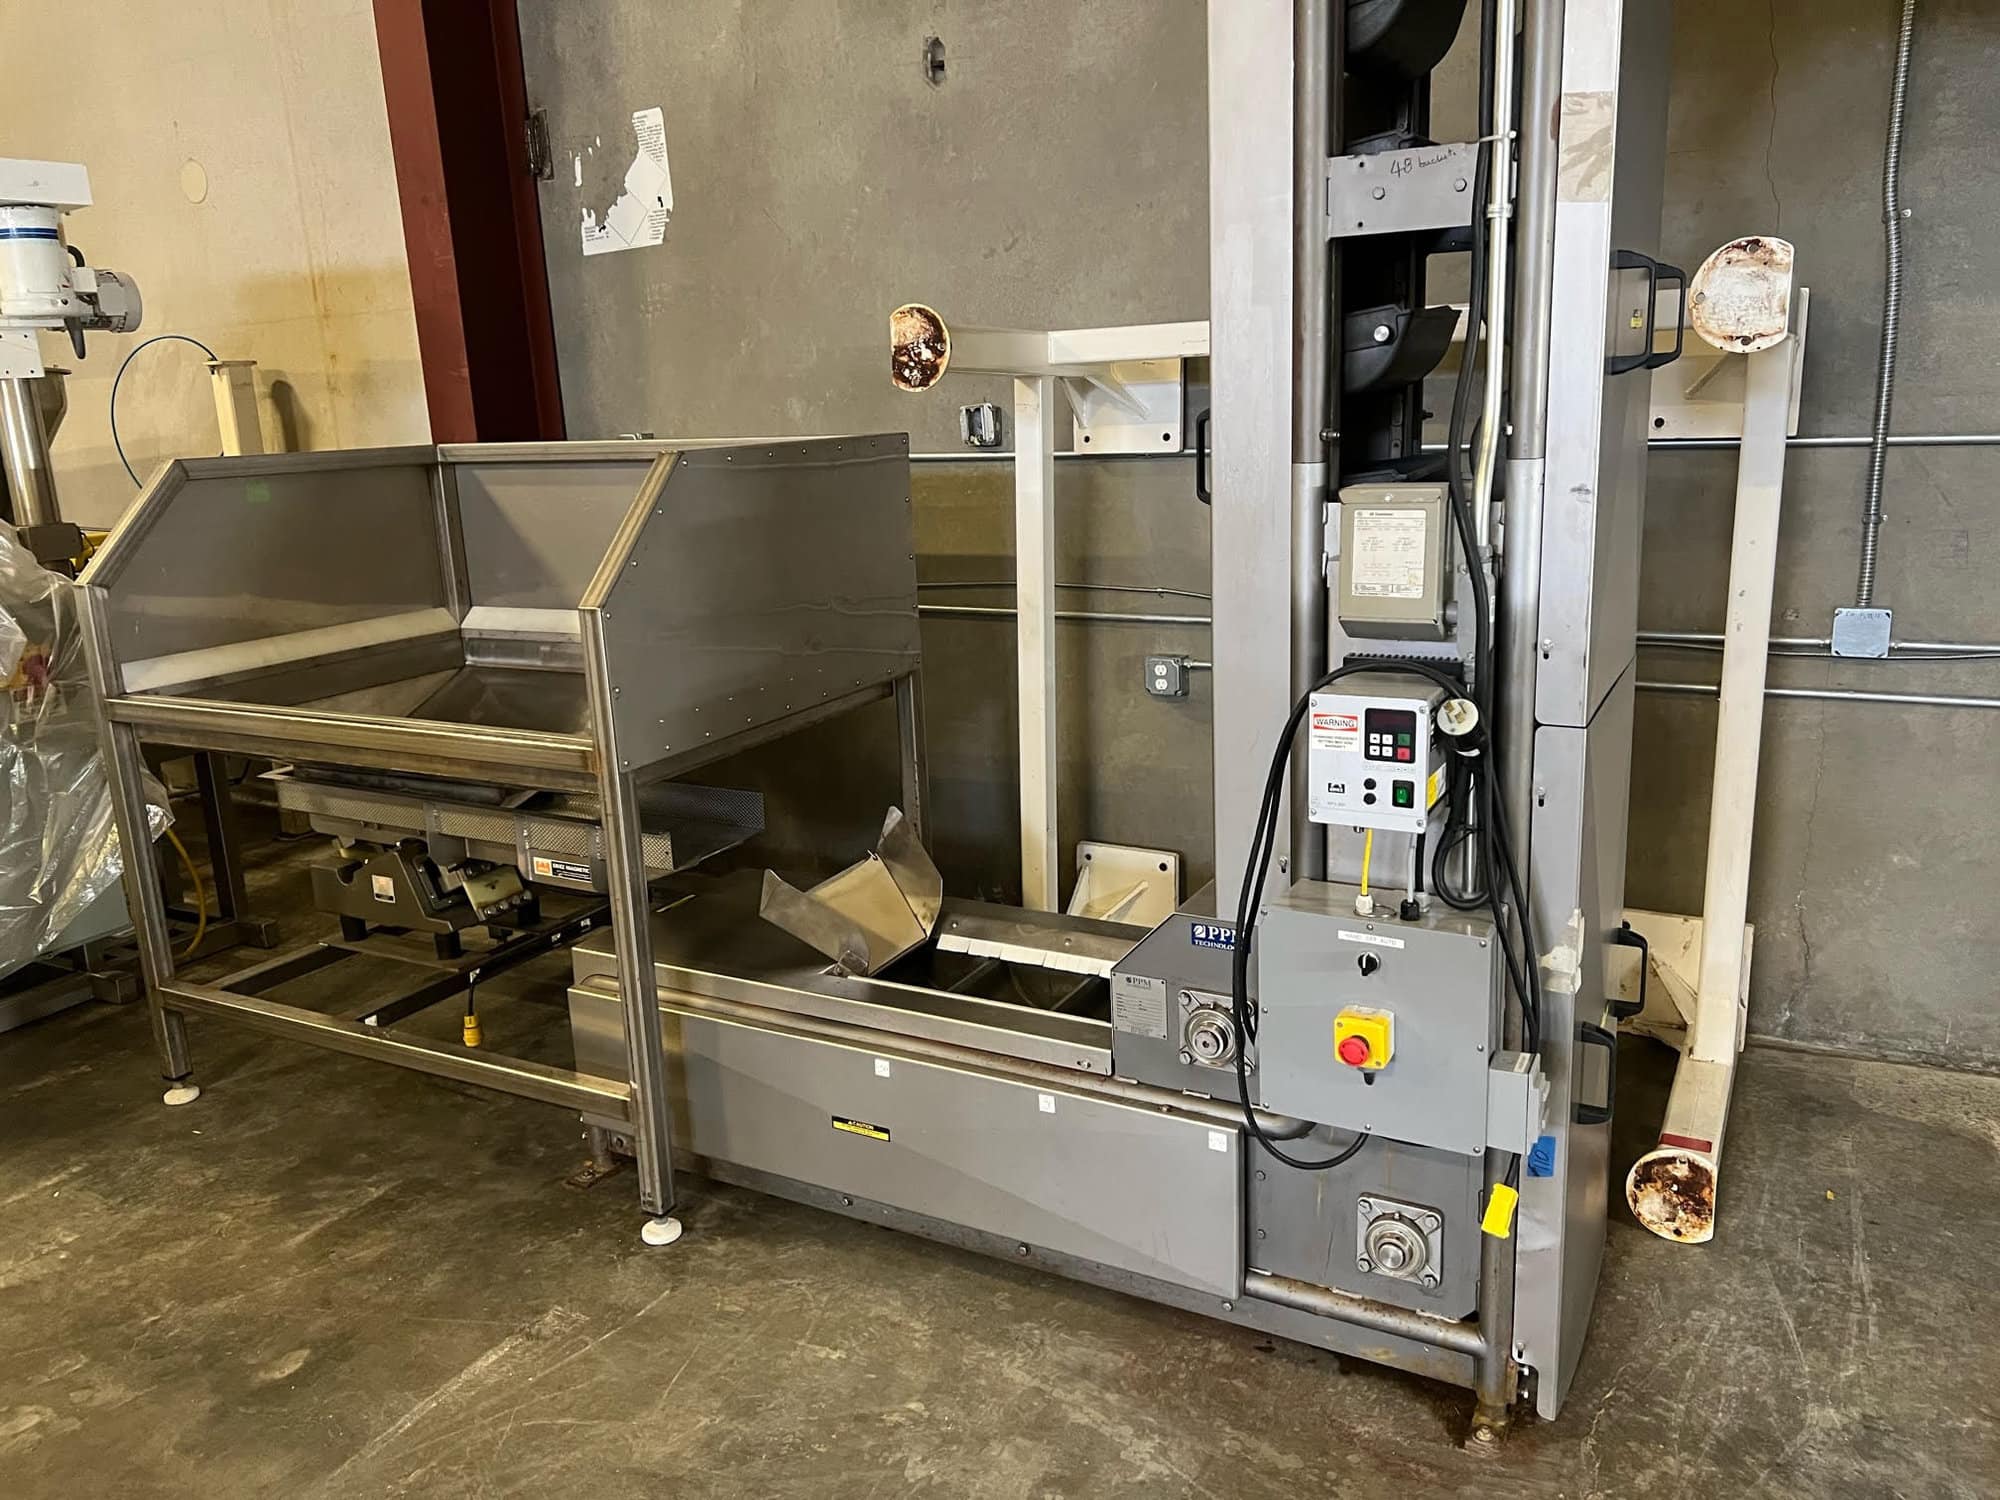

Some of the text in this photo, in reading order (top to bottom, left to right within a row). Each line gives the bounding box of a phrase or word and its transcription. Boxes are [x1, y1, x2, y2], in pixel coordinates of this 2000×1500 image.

[1390, 157, 1413, 178] 48
[1316, 718, 1355, 728] WARNING
[1194, 939, 1235, 950] TECHNOLO
